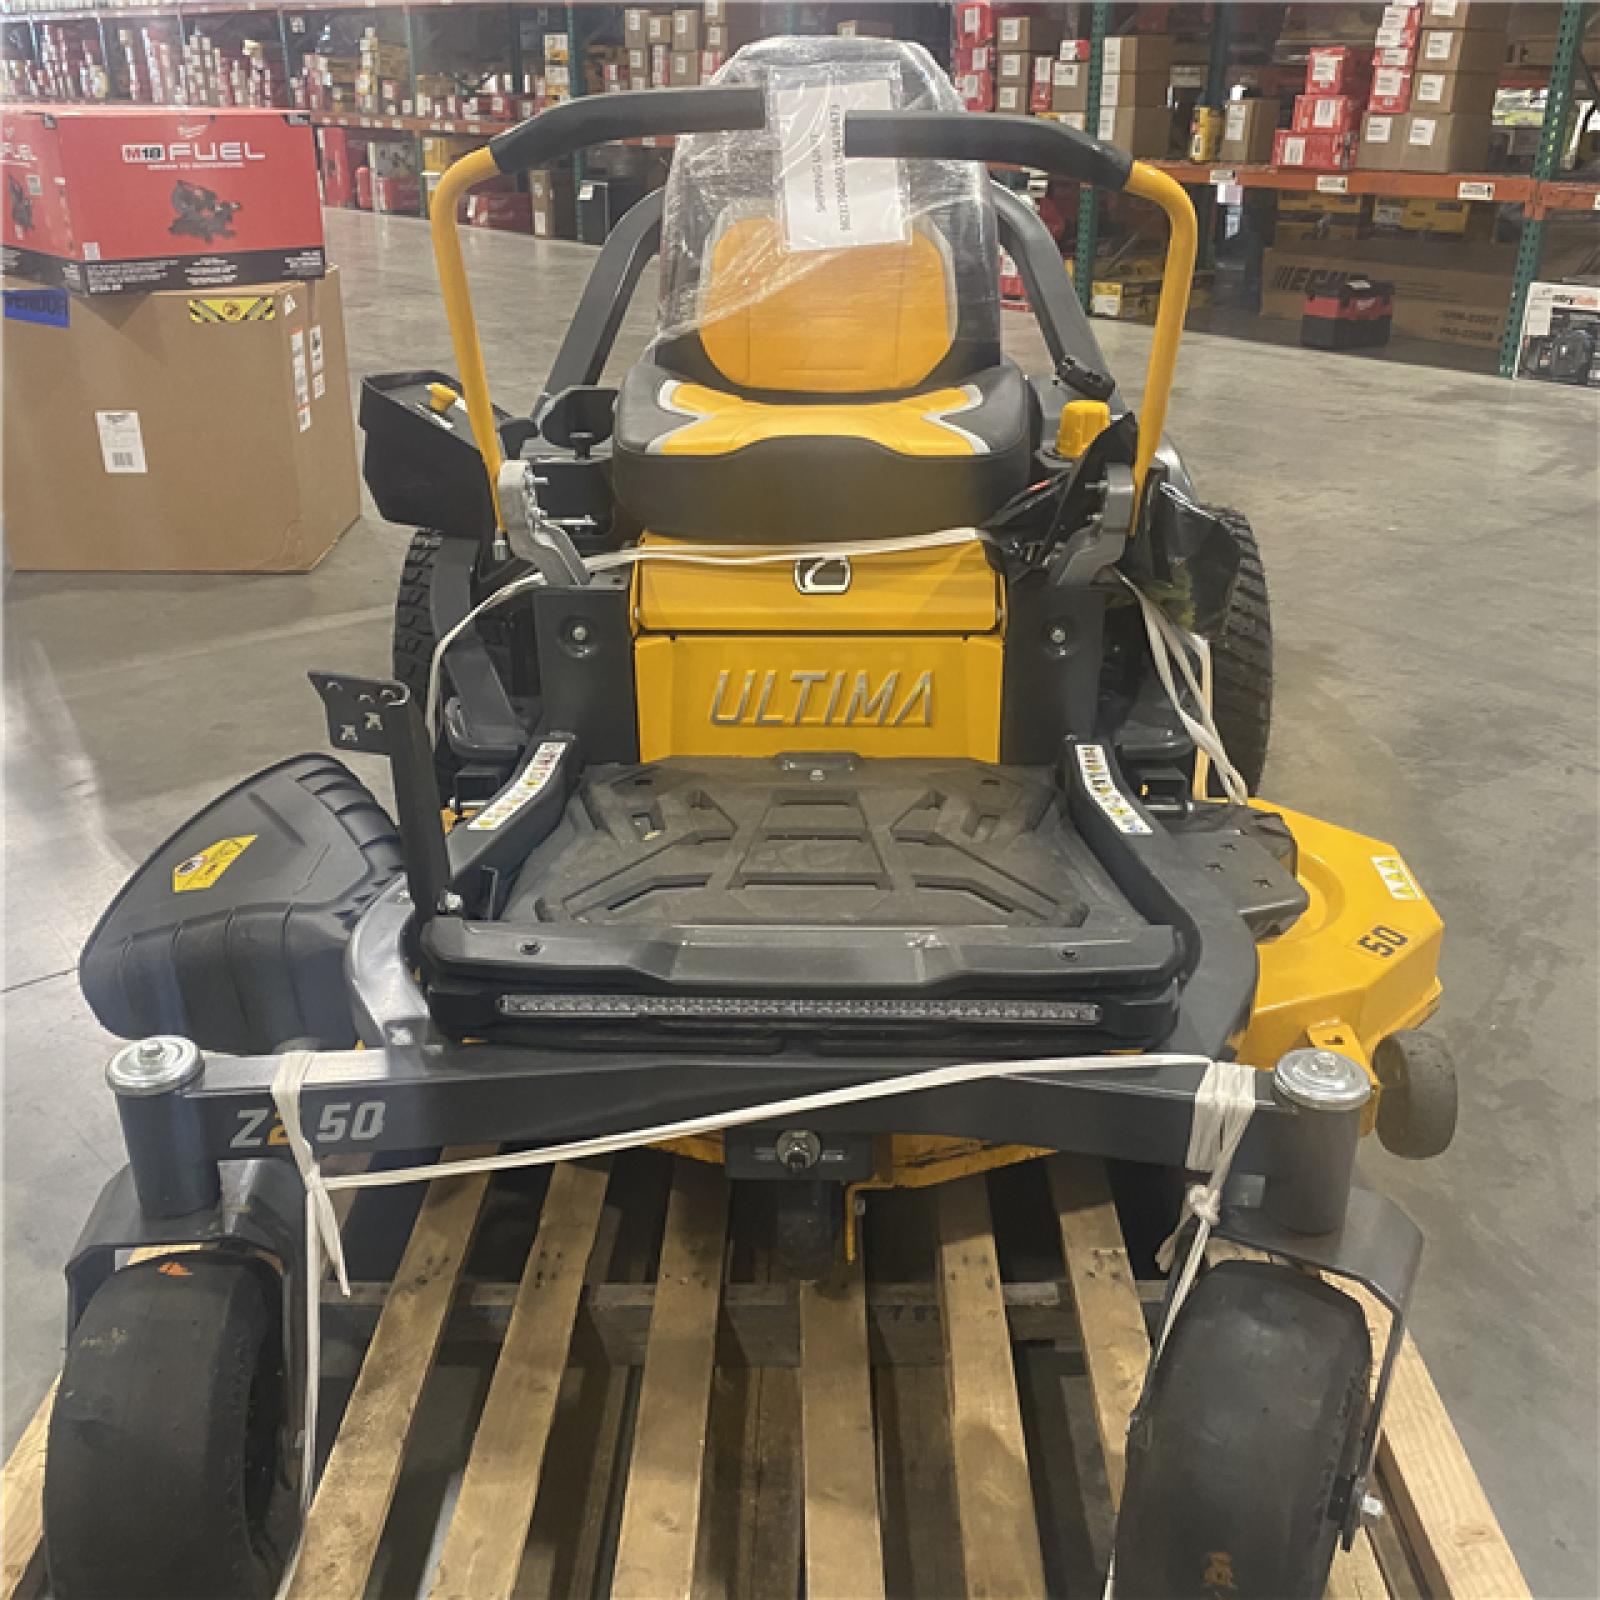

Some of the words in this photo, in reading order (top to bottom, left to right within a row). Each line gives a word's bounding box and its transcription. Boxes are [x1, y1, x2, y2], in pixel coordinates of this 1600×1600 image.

[169, 142, 266, 161] FUEL
[710, 669, 934, 727] ULTIMA
[1357, 924, 1409, 957] 50
